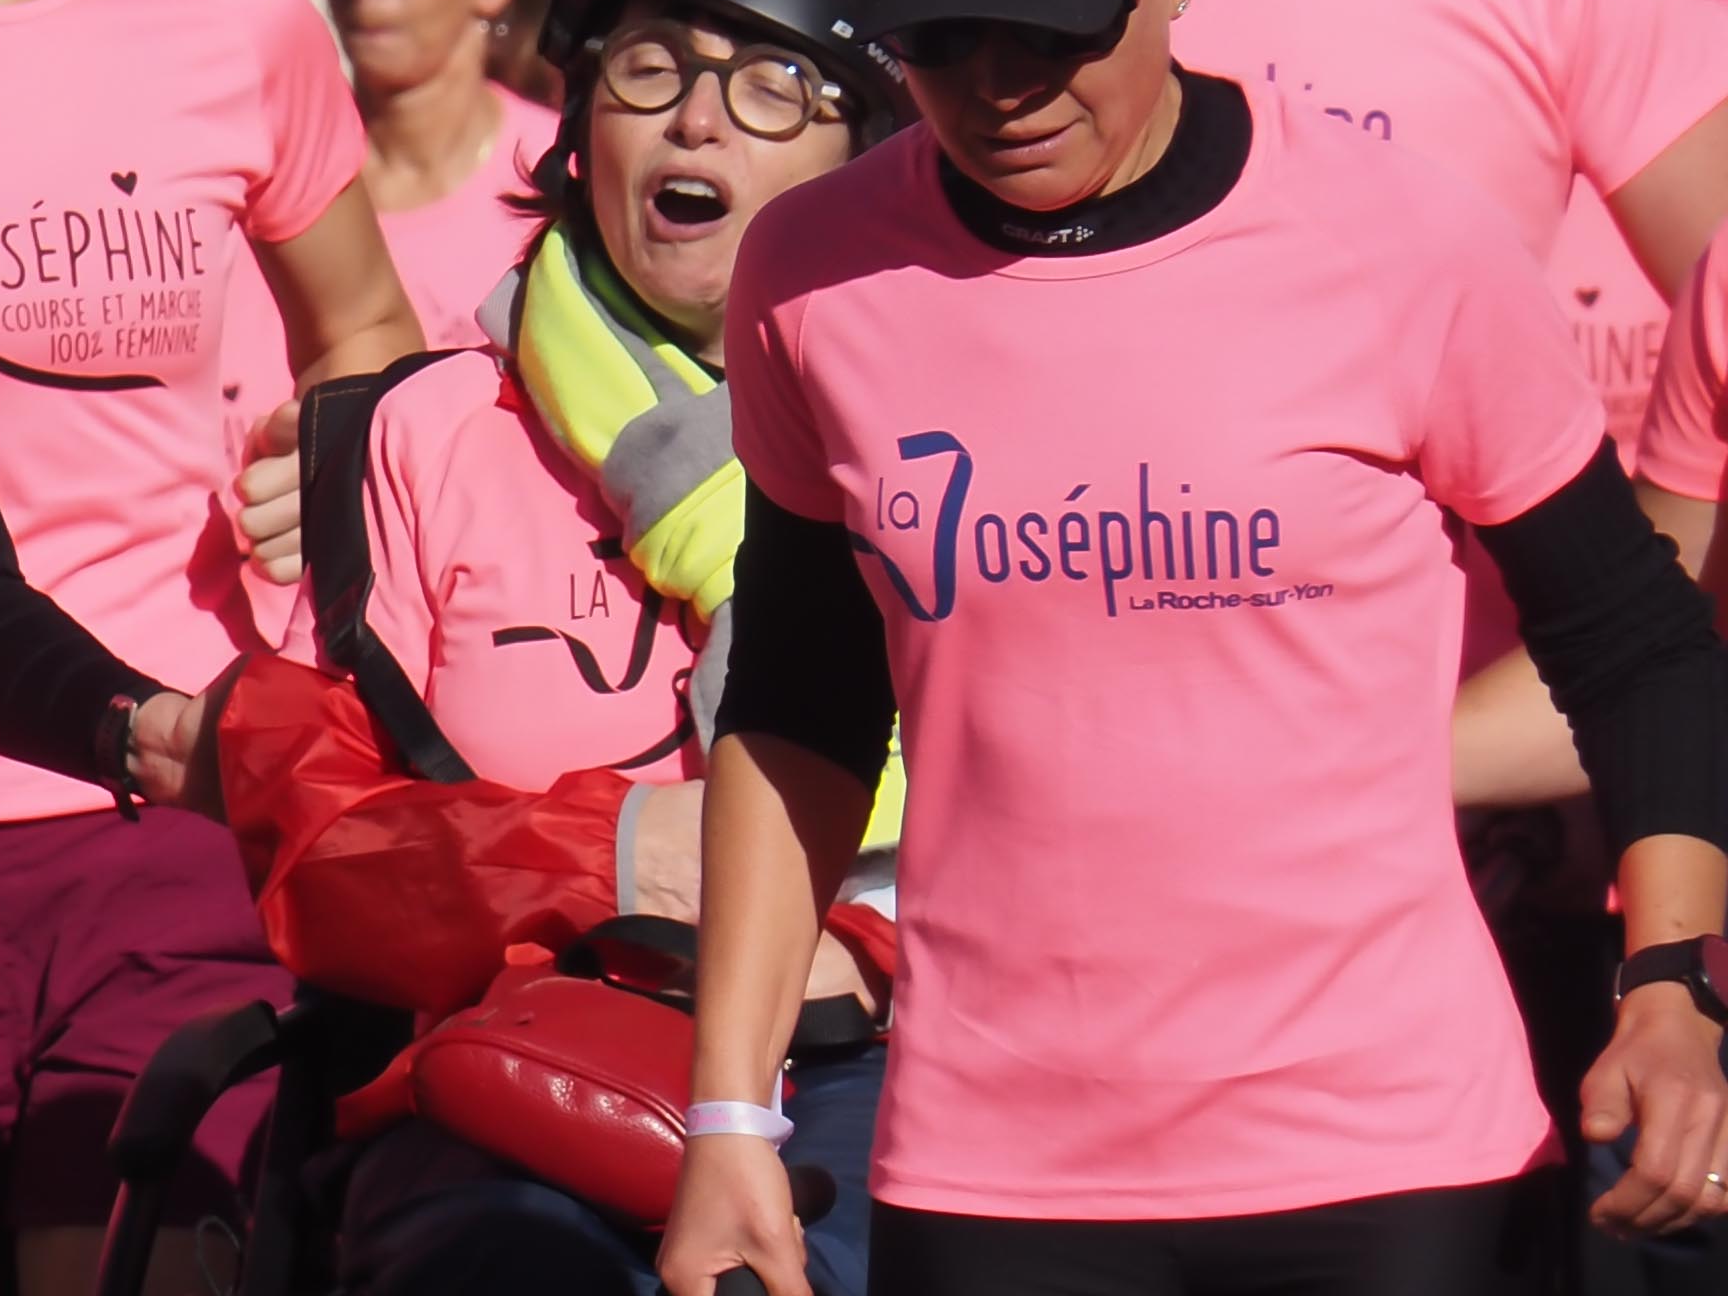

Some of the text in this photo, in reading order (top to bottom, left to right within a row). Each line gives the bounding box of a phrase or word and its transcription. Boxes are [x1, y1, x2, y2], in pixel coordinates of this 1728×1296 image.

[1, 289, 202, 333] COURSE ET MARCHE
[115, 320, 202, 359] FÉMININE
[853, 430, 1281, 623] Joséphine
[569, 569, 610, 621] LA
[1129, 582, 1334, 611] La Roche-sur-Yon
